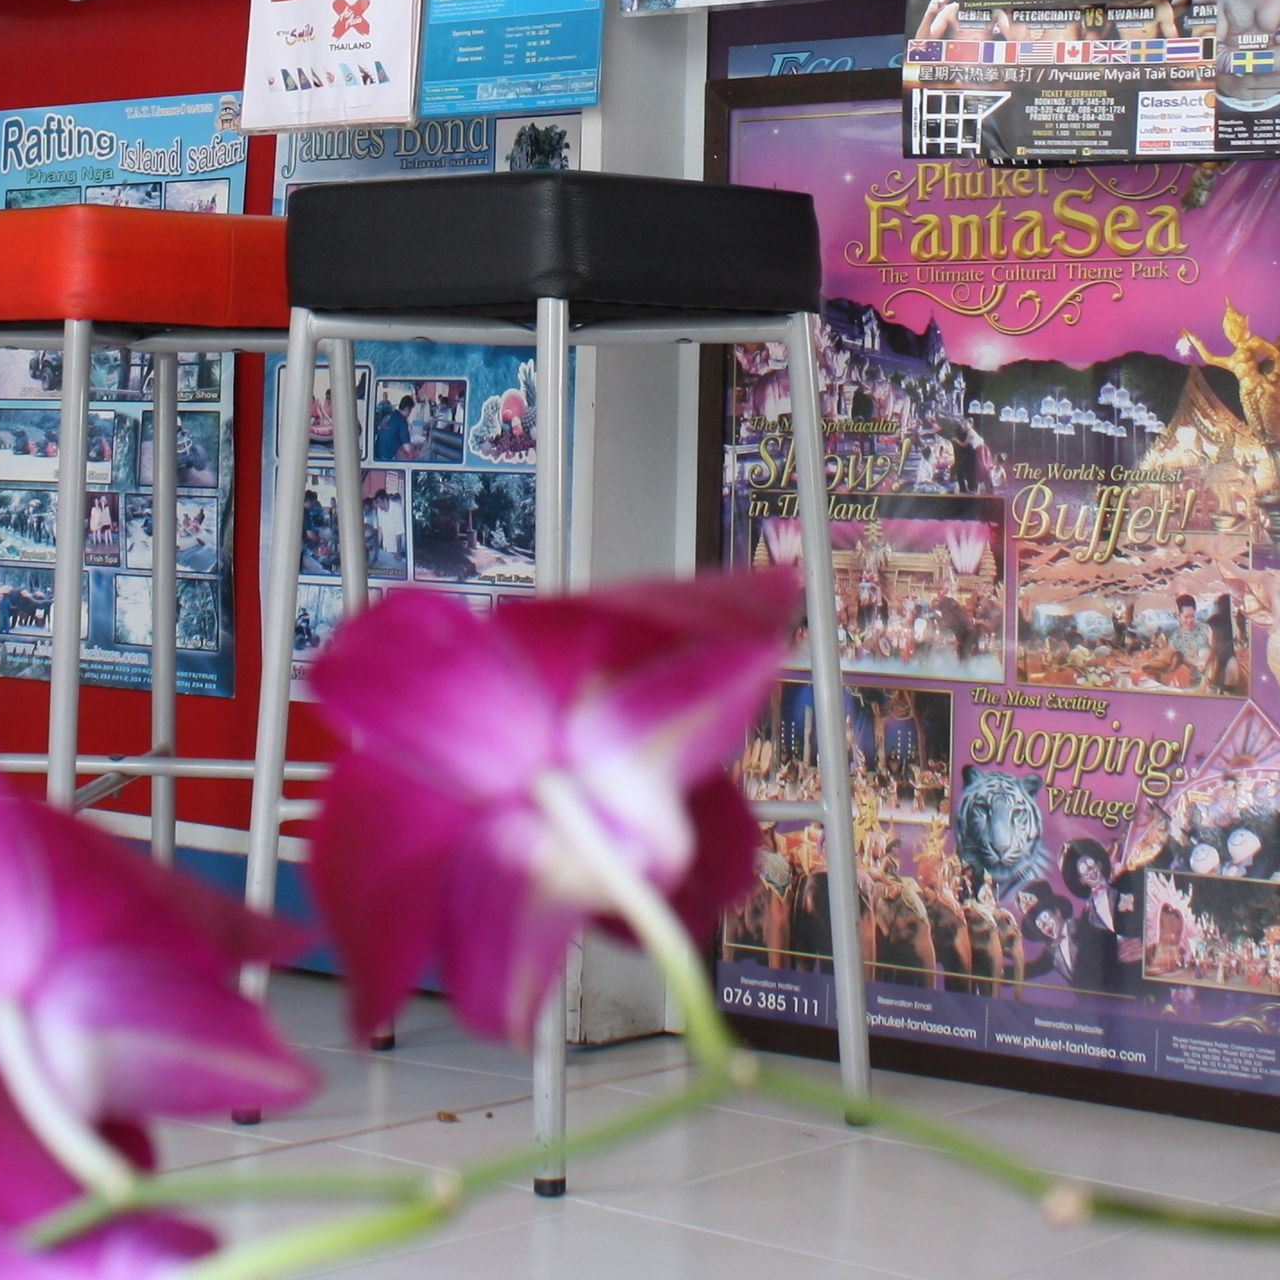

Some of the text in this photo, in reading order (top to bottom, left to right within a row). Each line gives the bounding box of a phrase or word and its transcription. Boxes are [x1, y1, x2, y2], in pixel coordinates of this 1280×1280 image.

[329, 41, 372, 52] THAILAND
[1047, 67, 1102, 83] Лучшие
[1103, 65, 1141, 81] Муай
[1140, 94, 1204, 109] ClassAct
[0, 112, 247, 176] Rafting Island safari
[26, 166, 114, 185] Phang Nga
[399, 155, 489, 169] Island safari
[915, 162, 1050, 202] Phuket
[863, 186, 1189, 265] FantaSea
[878, 261, 1170, 285] The Ultimate Cultural Theme Park
[1011, 462, 1184, 483] The World's Grandest
[1011, 477, 1196, 564] Buffet!
[970, 686, 1109, 719] The Most Exciting
[970, 707, 1195, 797] Shopping!
[1046, 785, 1137, 828] Village
[722, 986, 819, 1017] 076 385 111
[994, 1030, 1147, 1064] www.phuket-fantasea.com
